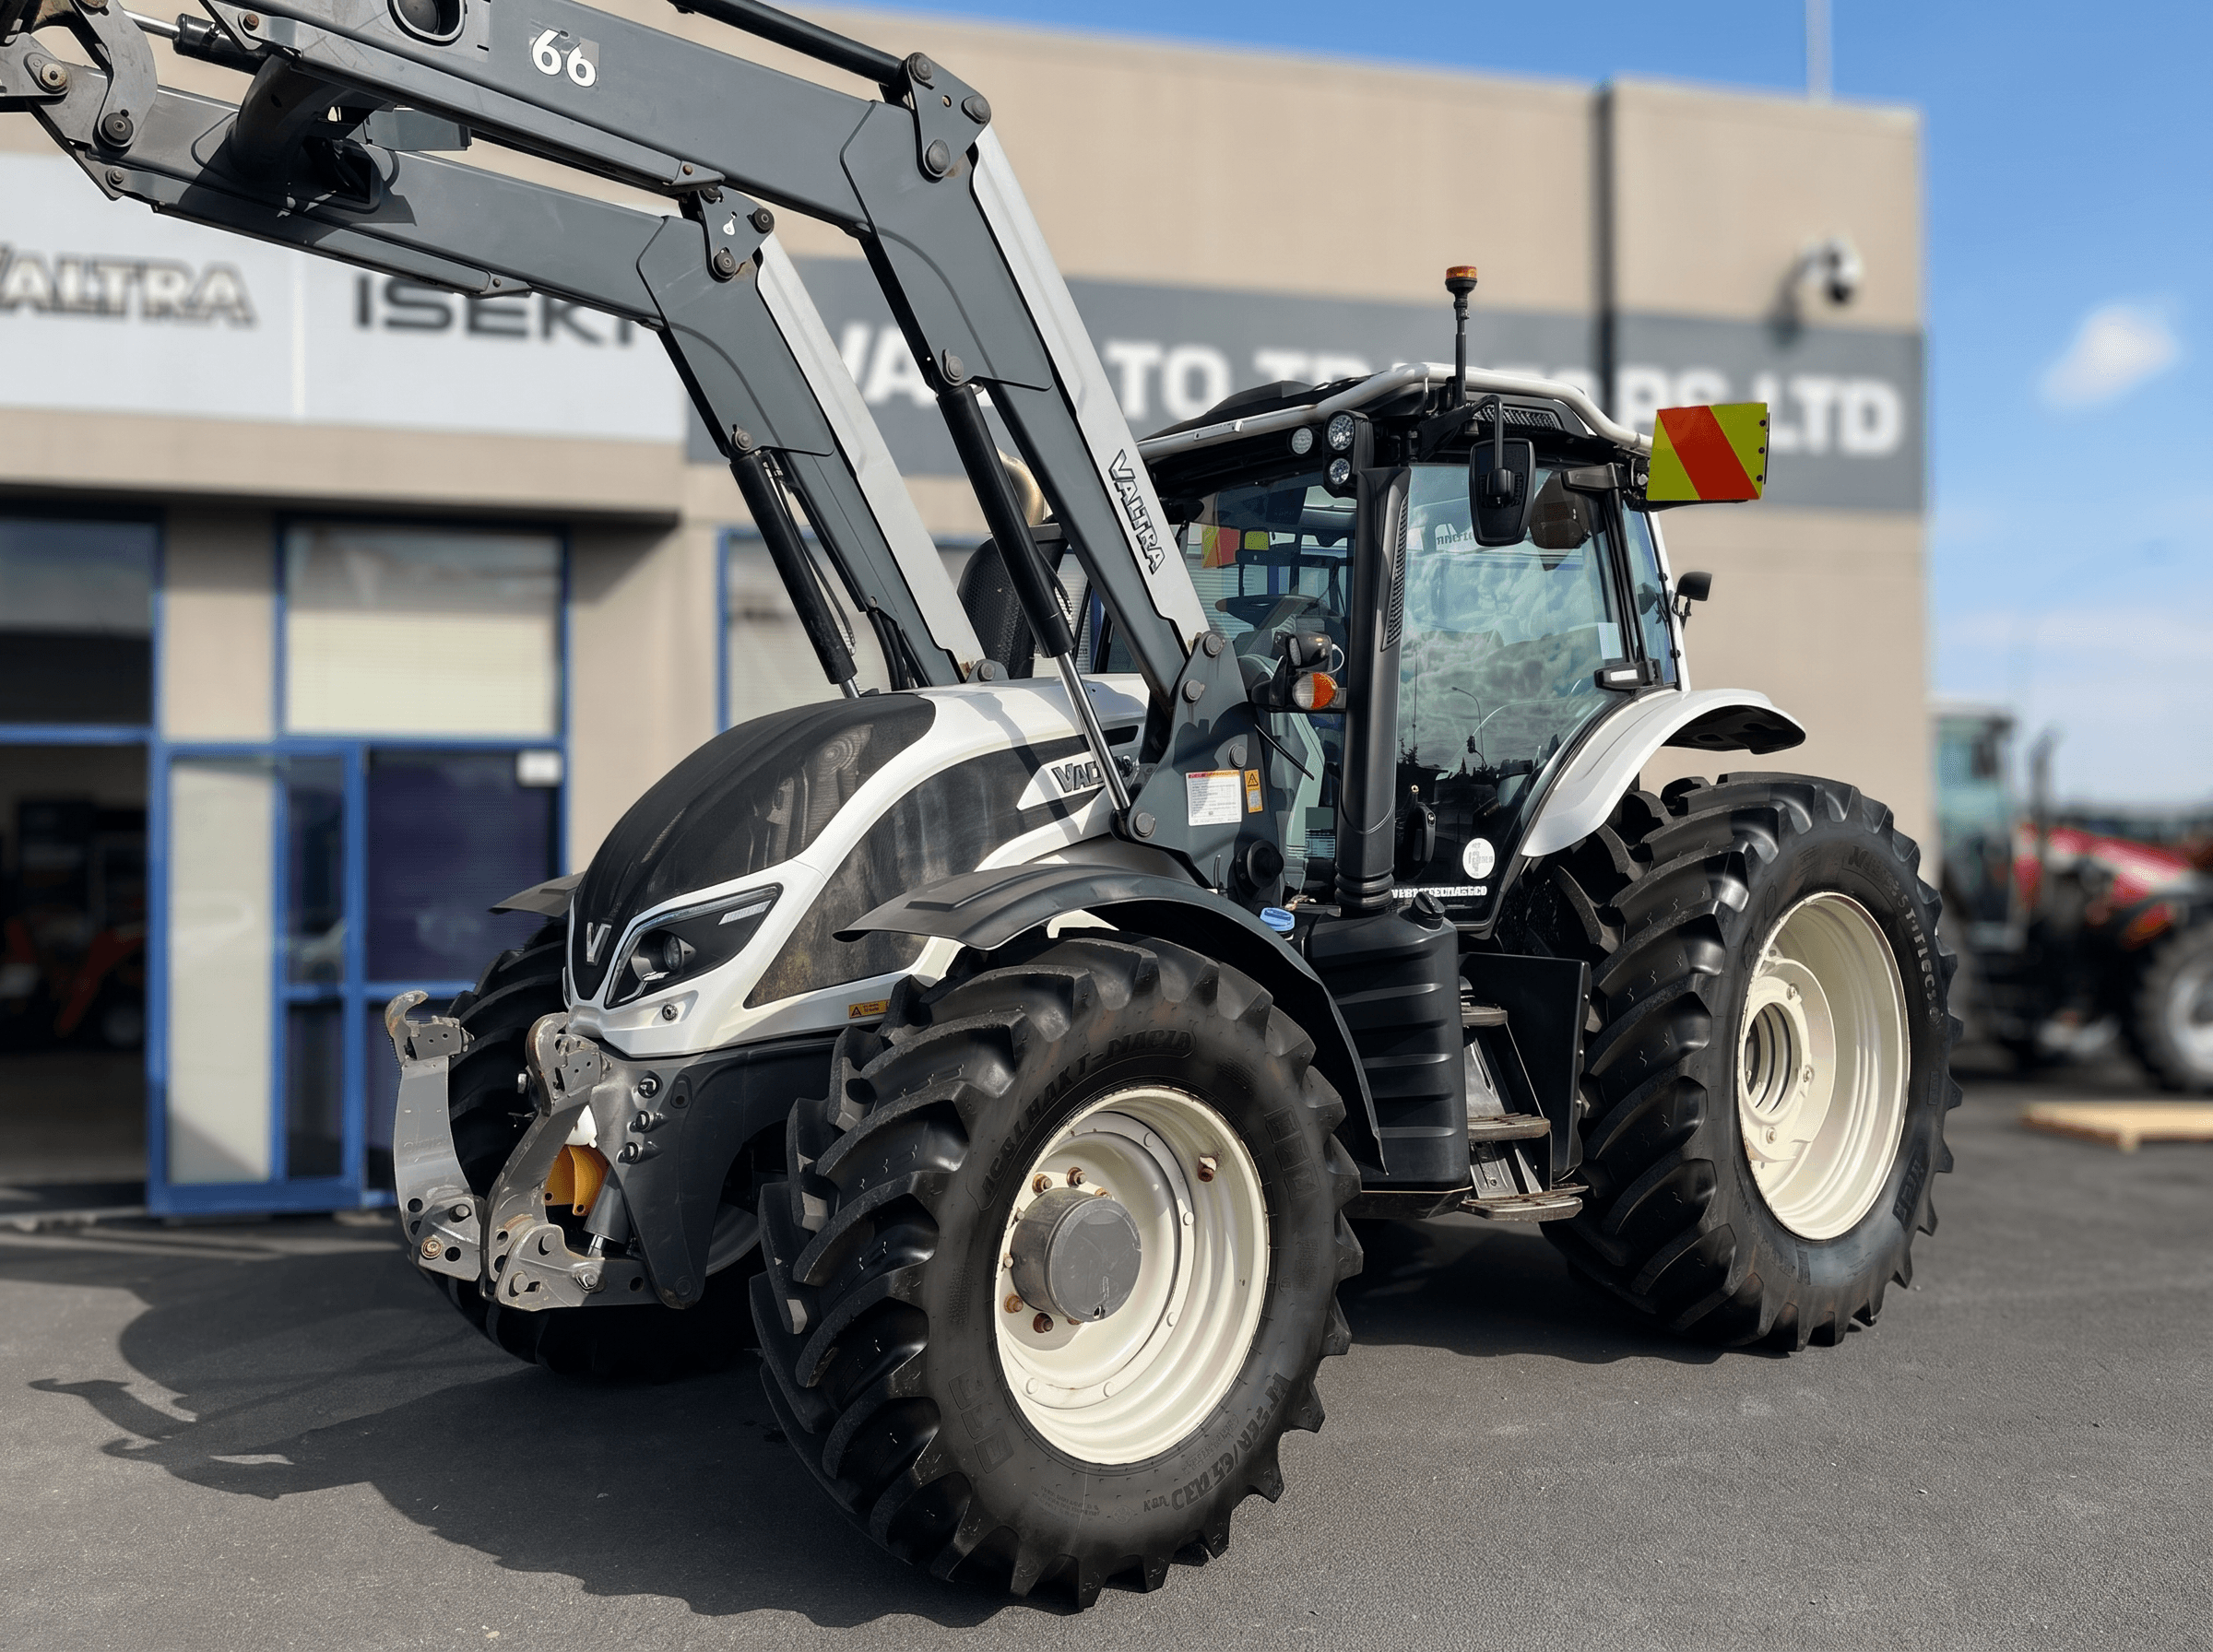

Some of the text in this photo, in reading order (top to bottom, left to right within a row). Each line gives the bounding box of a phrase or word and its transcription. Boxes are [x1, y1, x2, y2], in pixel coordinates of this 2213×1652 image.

[531, 28, 598, 88] 66
[0, 242, 258, 330] ALTRA
[1108, 448, 1166, 575] VALTRA
[1051, 760, 1106, 794] VAL
